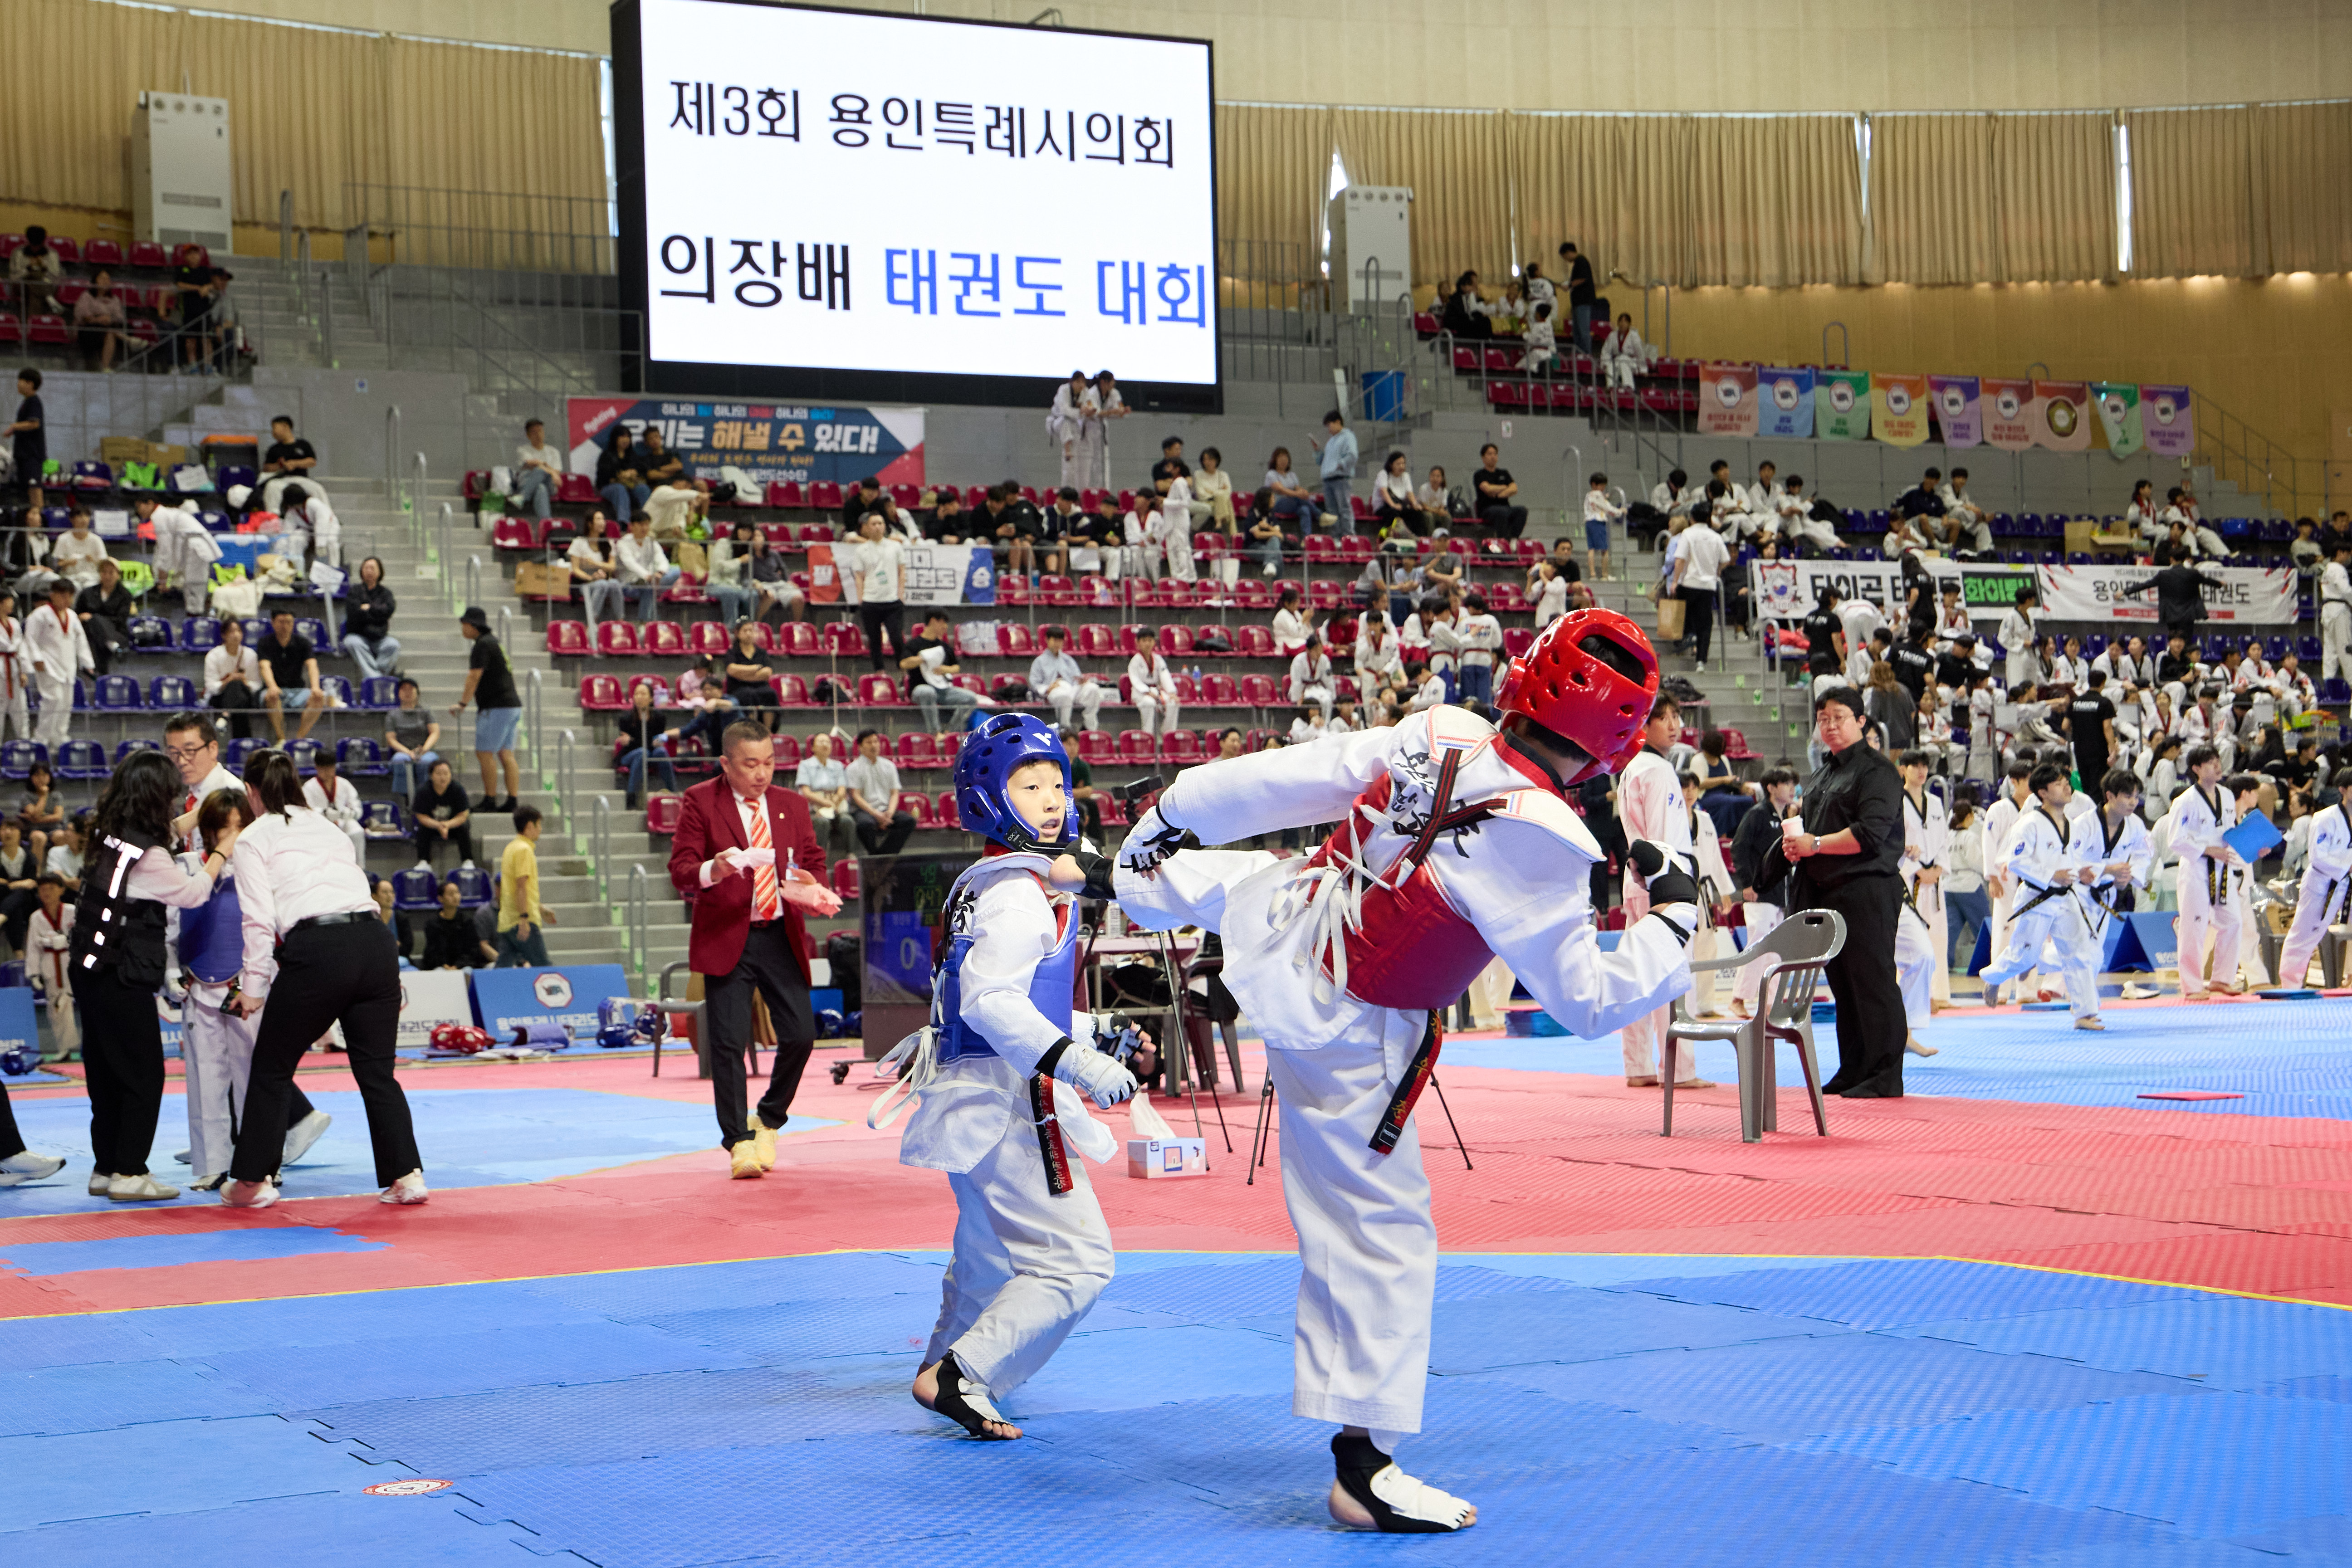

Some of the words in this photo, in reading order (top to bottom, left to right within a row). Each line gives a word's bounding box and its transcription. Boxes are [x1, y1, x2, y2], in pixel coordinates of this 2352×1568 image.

[670, 81, 800, 142] 제3회
[829, 94, 1173, 168] 용인특례시의회
[660, 234, 850, 311] 의장배
[885, 248, 1066, 317] 태권도
[1097, 260, 1206, 327] 대회
[711, 420, 771, 451] 해낼
[777, 423, 805, 451] 수
[814, 423, 880, 454] 있다!
[900, 937, 915, 970] 0
